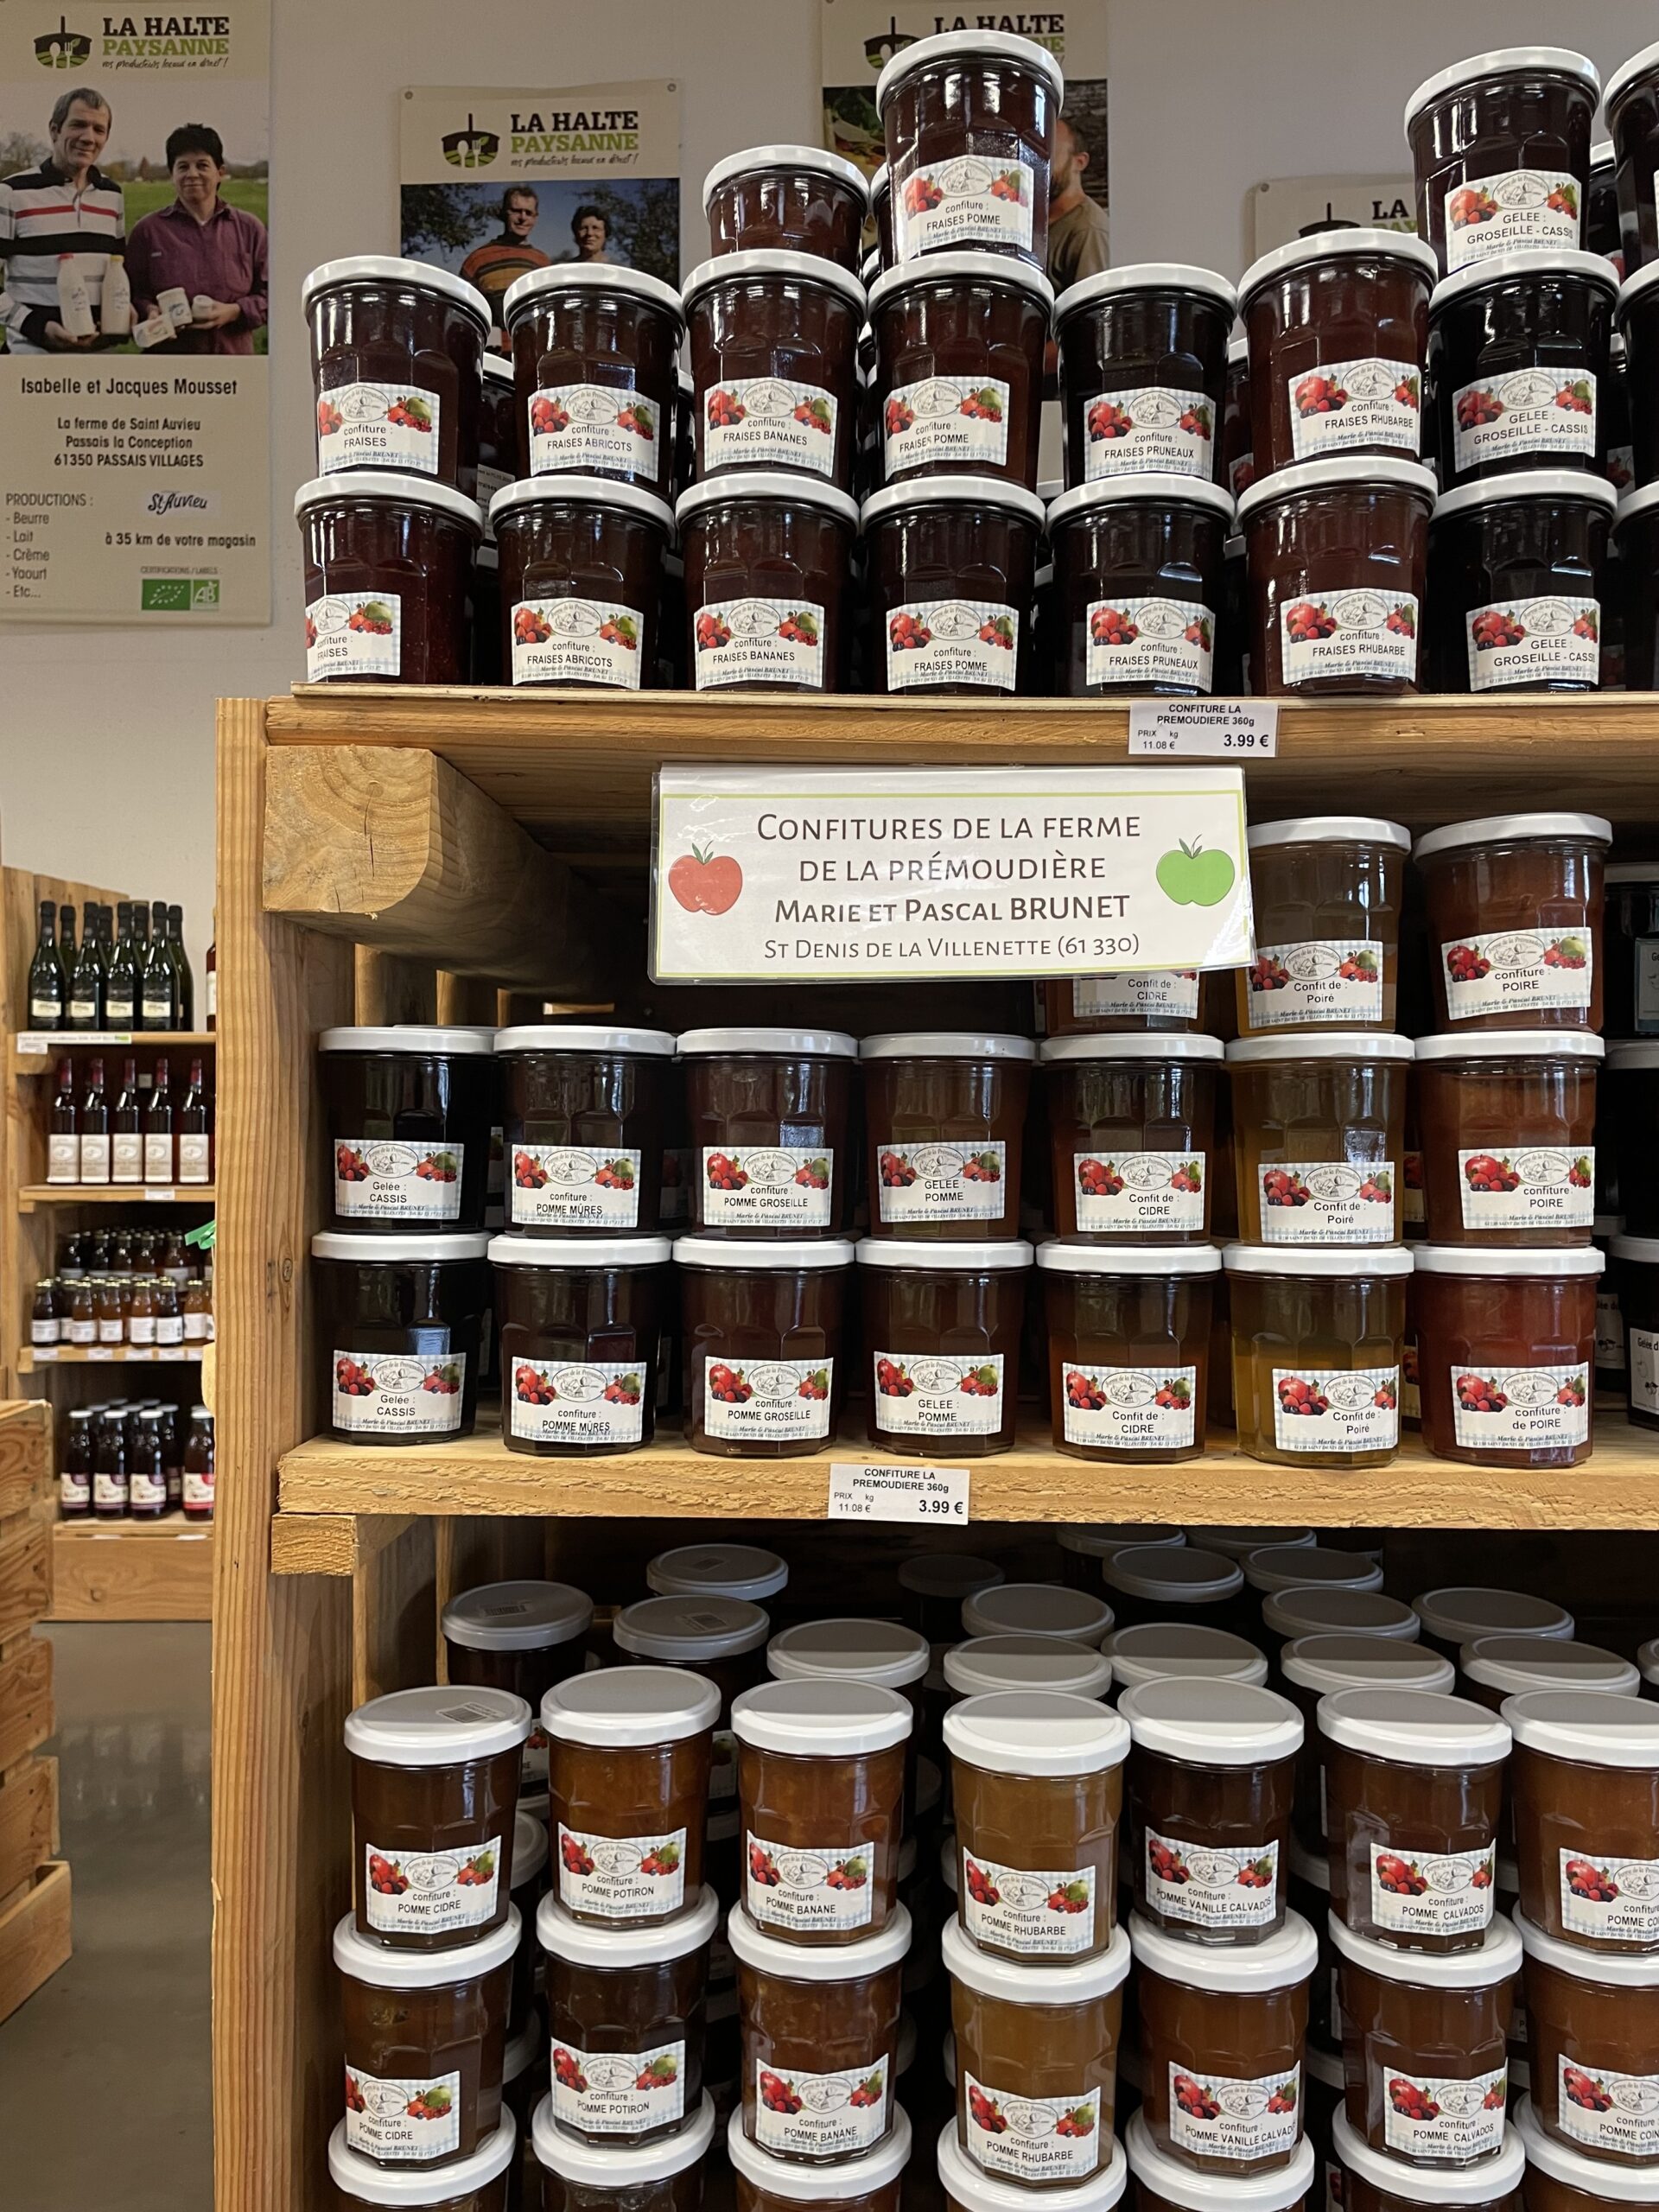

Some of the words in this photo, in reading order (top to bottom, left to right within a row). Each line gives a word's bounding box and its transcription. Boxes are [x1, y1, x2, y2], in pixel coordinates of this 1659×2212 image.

[103, 17, 137, 36] LA
[144, 17, 229, 36] HALTE
[934, 16, 967, 34] LA
[976, 14, 1064, 33] HALTE
[103, 38, 229, 55] PAYSANNE
[511, 112, 545, 133] LA
[552, 111, 639, 130] HALTE
[511, 132, 639, 154] PAYSANNE
[1372, 199, 1409, 220] LA
[926, 215, 964, 232] FRAISES
[967, 213, 1001, 225] POMME
[1503, 212, 1540, 225] GELEE
[21, 378, 80, 394] Isabelle
[87, 379, 101, 394] et
[105, 378, 168, 397] Jacques
[175, 378, 238, 395] Mousset
[58, 417, 71, 429] La
[74, 417, 108, 429] ferme
[111, 417, 126, 430] de
[130, 417, 159, 430] Saint
[162, 418, 201, 430] Auvieu
[1325, 415, 1368, 429] FRAISES
[1371, 415, 1414, 429] RHUBARBE
[66, 435, 109, 448] Passais
[113, 436, 124, 448] la
[128, 436, 193, 450] Conception
[344, 437, 387, 448] FRAISES
[723, 432, 761, 442] FRAISES
[764, 431, 808, 446] BANANES
[548, 439, 582, 450] FRAISES
[585, 439, 632, 452] ABRICOTS
[1104, 447, 1144, 459] FRAISES
[1147, 447, 1194, 459] PRUNEAUX
[54, 454, 93, 466] 61350
[97, 454, 147, 467] PASSAIS
[149, 454, 204, 467] VILLAGES
[6, 493, 87, 506] PRODUCTIONS
[13, 512, 49, 524] Beurre
[13, 531, 34, 543] Lait
[105, 532, 112, 545] à
[116, 533, 132, 545] 35
[136, 533, 153, 545] km
[156, 533, 171, 545] de
[175, 535, 204, 546] votre
[207, 533, 256, 549] magasin
[13, 548, 50, 561] Crème
[12, 566, 48, 580] Yaourt
[527, 654, 563, 664] FRAISES
[565, 654, 613, 667] ABRICOTS
[713, 652, 747, 664] FRAISES
[750, 651, 795, 661] BANANES
[1109, 656, 1149, 666] FRAISES
[1153, 656, 1198, 670] PRUNEAUX
[1169, 704, 1225, 714] CONFITURE
[1229, 705, 1241, 714] LA
[1157, 715, 1230, 725] PREMOUDIERE
[1232, 717, 1255, 727] 360g
[1224, 734, 1255, 747] 3.99
[1260, 734, 1269, 747] €
[758, 814, 942, 840] CONFITURES
[953, 818, 990, 839] DE
[1001, 818, 1033, 838] LA
[1044, 817, 1140, 837] FERME
[800, 861, 836, 881] DE
[847, 861, 878, 880] LA
[890, 849, 1105, 880] PRÉMOUDIÈRE
[776, 900, 861, 922] MARIE
[869, 905, 897, 921] ET
[906, 899, 1002, 921] PASCAL
[1011, 895, 1130, 920] BRUNET
[796, 940, 859, 958] DENIS
[867, 943, 893, 957] DE
[899, 943, 922, 957] LA
[928, 938, 1051, 957] VILLENETTE
[1058, 935, 1085, 957] (61
[1093, 934, 1139, 956] 330)
[1495, 968, 1545, 981] confiture
[1294, 981, 1326, 992] Confit
[1328, 981, 1341, 990] de
[1503, 980, 1540, 992] POIRE
[1136, 990, 1167, 1001] CIDRE
[1306, 993, 1335, 1004] Poiré
[372, 1181, 399, 1192] Gelée
[750, 1185, 788, 1195] confiture
[925, 1179, 960, 1190] GELEE
[1523, 1185, 1569, 1195] confiture
[369, 1193, 407, 1204] CASSIS
[550, 1192, 588, 1202] confiture
[724, 1198, 758, 1207] POMME
[760, 1198, 809, 1208] GROSEILLE
[925, 1192, 964, 1203] POMME
[1128, 1194, 1160, 1204] Confit
[1162, 1194, 1174, 1203] de
[1529, 1198, 1563, 1208] POIRE
[537, 1204, 568, 1215] POMME
[1138, 1205, 1171, 1216] CIDRE
[1313, 1202, 1345, 1212] Confit
[1349, 1202, 1360, 1211] de
[1327, 1213, 1354, 1225] Poiré
[380, 1394, 410, 1405] Gelée
[755, 1399, 792, 1409] confiture
[918, 1399, 953, 1409] GELEE
[377, 1407, 416, 1417] CASSIS
[558, 1408, 596, 1419] confiture
[728, 1409, 762, 1421] POMME
[764, 1409, 811, 1421] GROSEILLE
[1121, 1423, 1154, 1433] CIDRE
[1346, 1423, 1370, 1434] Poiré
[1512, 1421, 1526, 1430] de
[1530, 1419, 1561, 1430] POIRE
[864, 1469, 920, 1479] CONFITURE
[923, 1471, 935, 1480] LA
[853, 1478, 925, 1491] PREMOUDIERE
[926, 1483, 949, 1493] 360g
[839, 1503, 862, 1512] 11.08
[918, 1500, 950, 1513] 3.99
[954, 1502, 963, 1514] €
[582, 1883, 611, 1898] POMME
[613, 1886, 654, 1899] POTIRON
[766, 1897, 794, 1913] POMME
[797, 1904, 836, 1914] BANANE
[1402, 1906, 1438, 1918] POMME
[1444, 1904, 1484, 1920] CALVADOS
[982, 1914, 1012, 1931] POMME
[1014, 1925, 1066, 1936] RHUBARBE
[785, 2127, 817, 2141] POMME
[821, 2126, 857, 2142] BANANE
[1185, 2125, 1217, 2141] POMME
[1221, 2133, 1260, 2146] VANILLE
